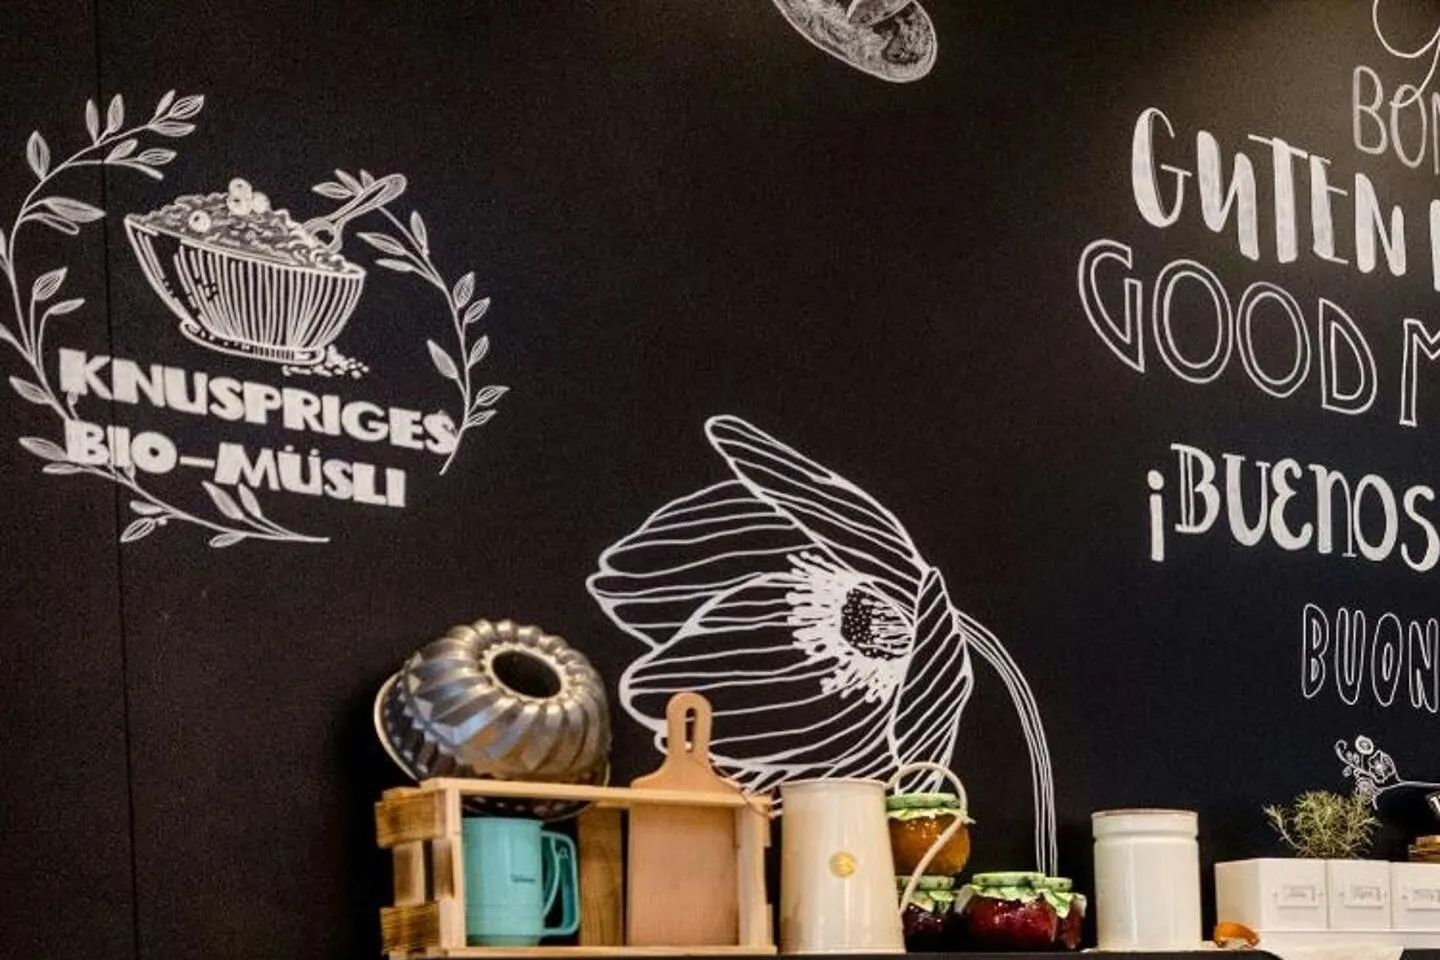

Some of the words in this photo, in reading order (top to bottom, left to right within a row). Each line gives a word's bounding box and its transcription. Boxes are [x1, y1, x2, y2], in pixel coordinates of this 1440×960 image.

[1131, 107, 1407, 276] GUTEN
[1078, 238, 1378, 415] GOOD
[58, 347, 458, 455] KNUSPRIGES
[65, 418, 406, 507] BIO-MÜSLI
